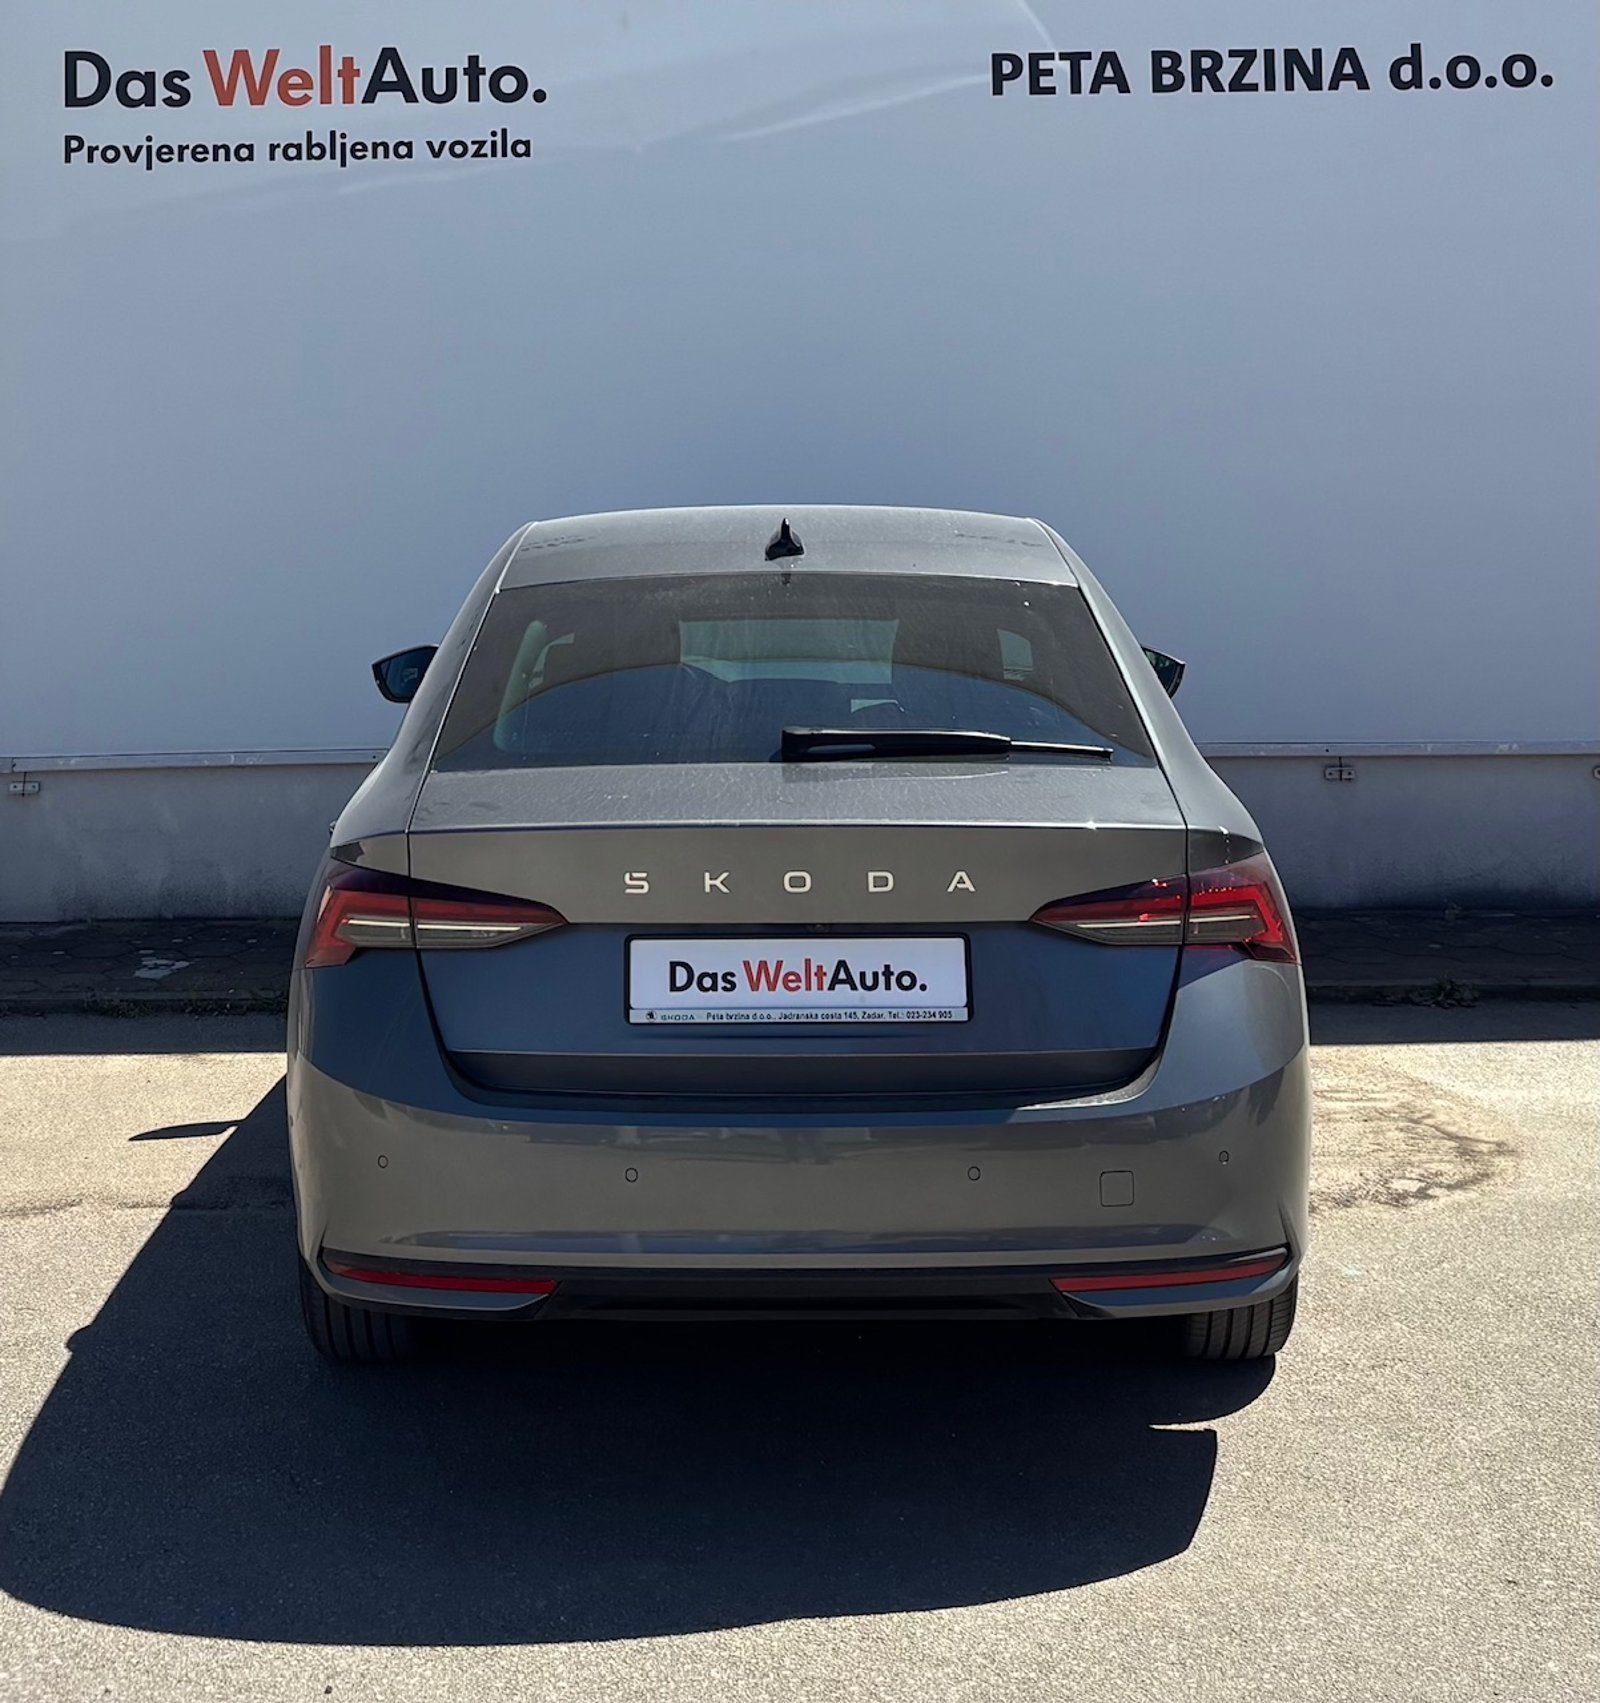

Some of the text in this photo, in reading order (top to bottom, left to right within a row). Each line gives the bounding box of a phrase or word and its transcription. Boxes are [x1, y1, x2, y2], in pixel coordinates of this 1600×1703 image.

[63, 45, 548, 108] Das WeltAuto.
[991, 42, 1554, 96] PETA BRZINA d.o.o.
[63, 128, 532, 171] Provjerena rabljena vozila
[668, 958, 928, 992] Das WeltAuto.
